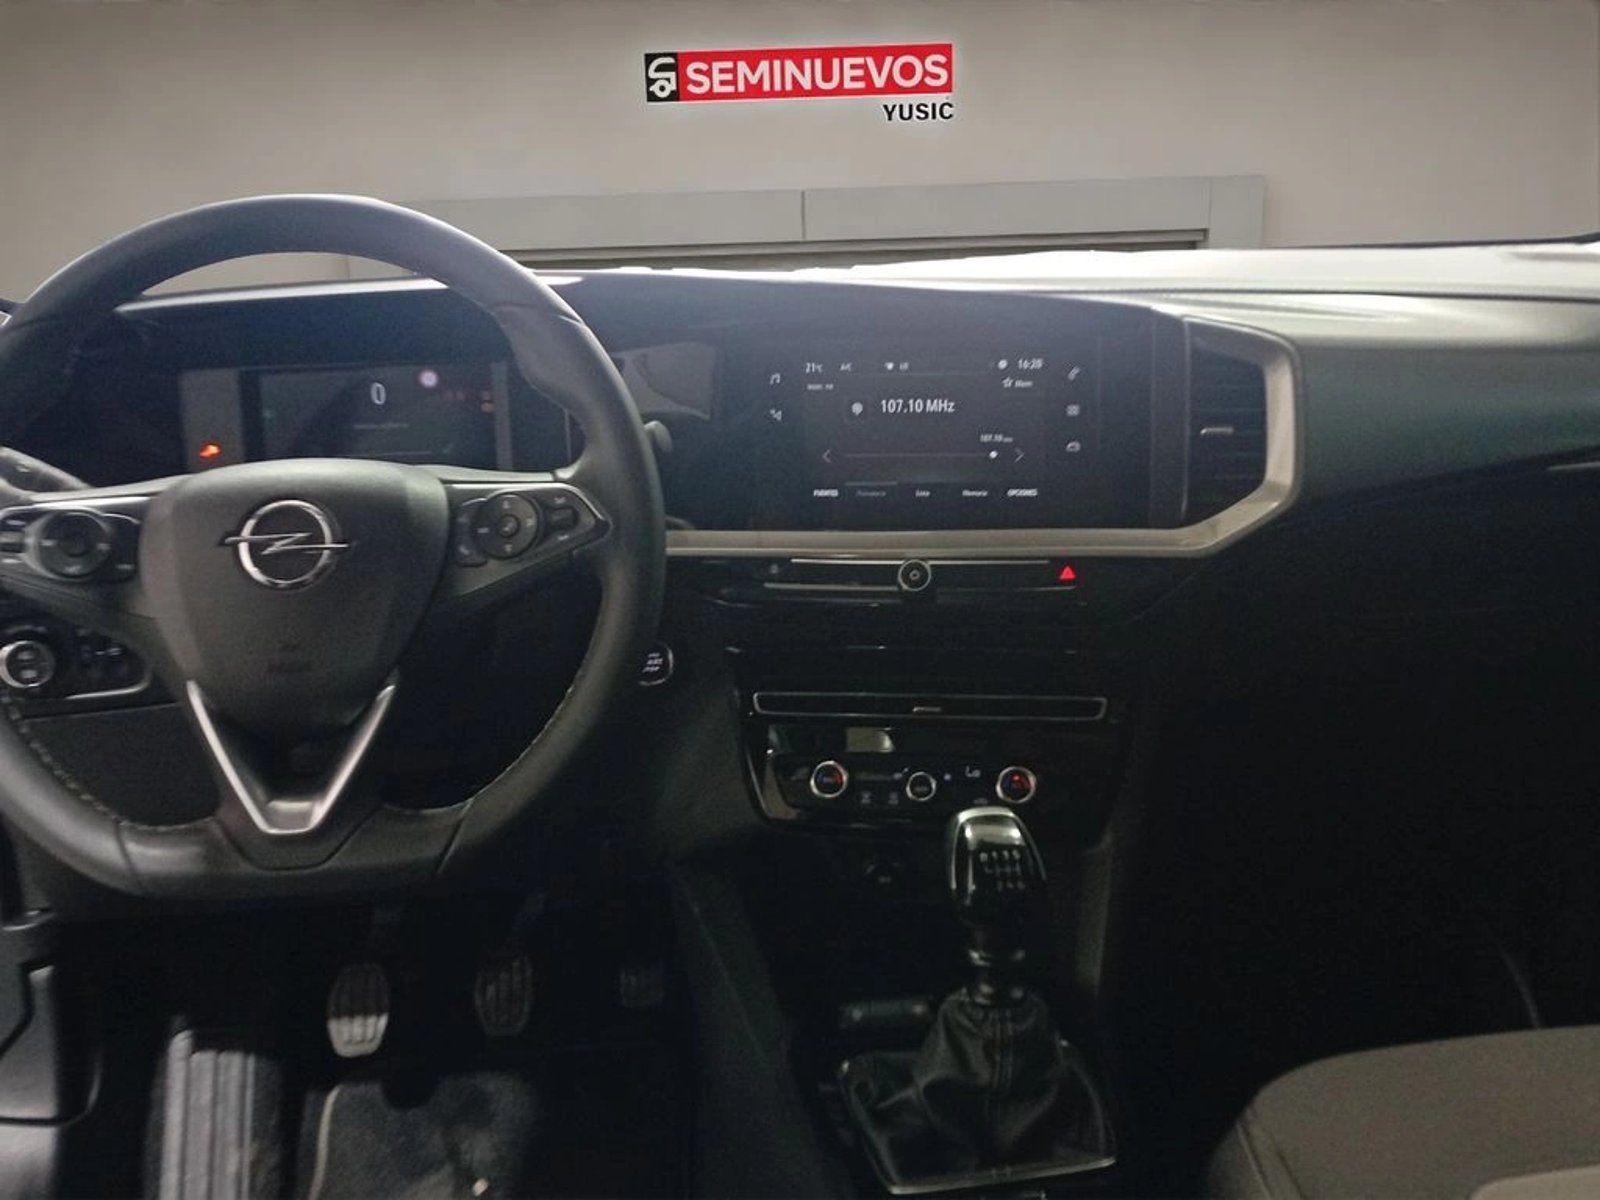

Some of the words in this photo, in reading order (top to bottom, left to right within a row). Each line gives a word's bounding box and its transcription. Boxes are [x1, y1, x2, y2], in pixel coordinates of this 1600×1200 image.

[686, 54, 948, 95] SEMINUEVOS
[882, 102, 954, 121] YUSIC
[370, 382, 386, 404] 0
[881, 398, 923, 413] 107.10
[926, 398, 955, 413] MHz
